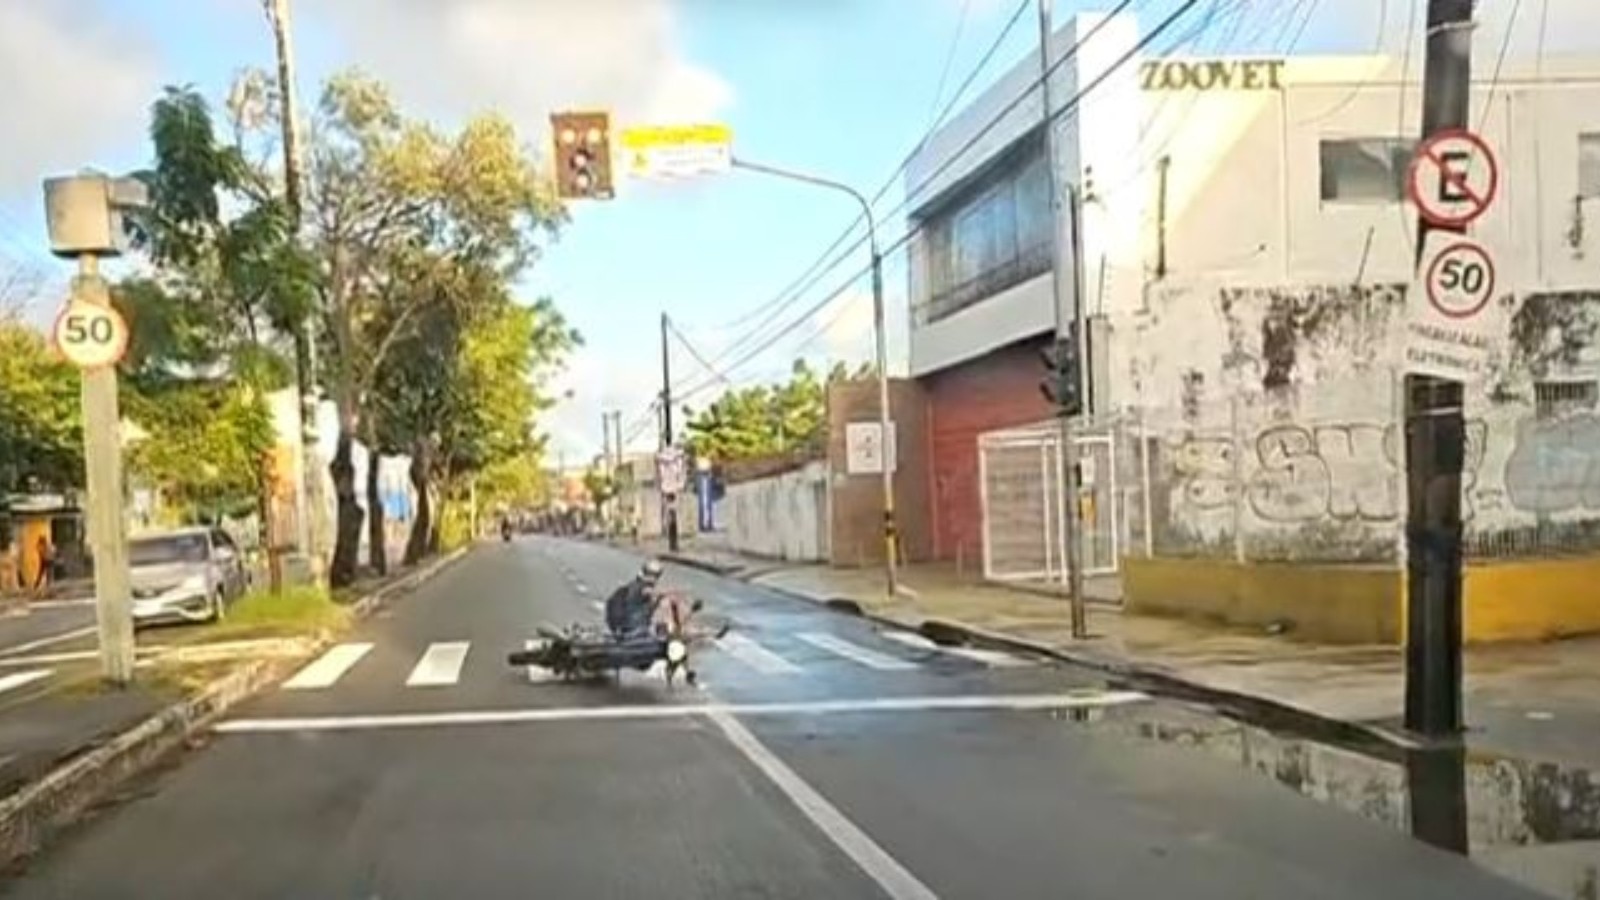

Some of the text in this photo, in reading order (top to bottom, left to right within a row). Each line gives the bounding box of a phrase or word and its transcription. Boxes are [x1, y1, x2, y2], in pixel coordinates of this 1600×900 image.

[1140, 59, 1285, 91] ZOOVET
[1439, 152, 1470, 202] E
[1439, 258, 1483, 294] 50
[65, 315, 114, 344] 50
